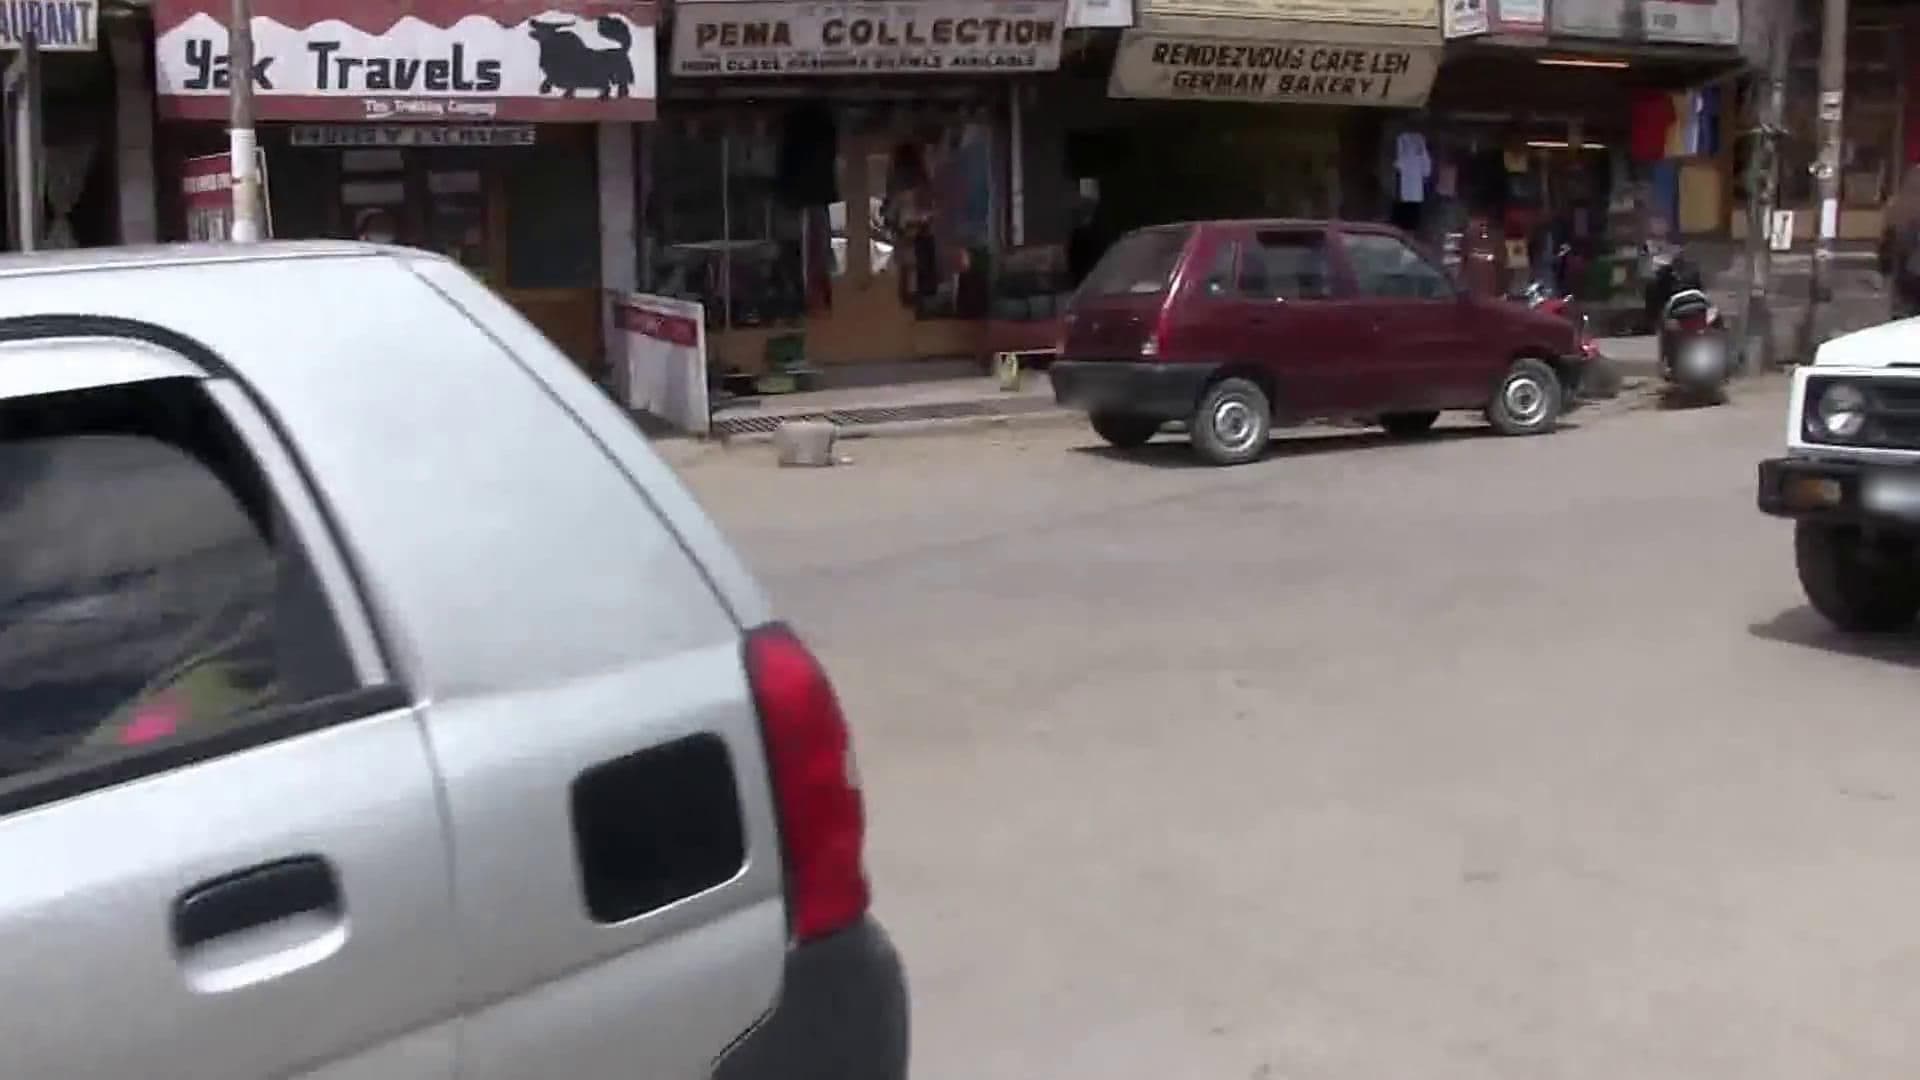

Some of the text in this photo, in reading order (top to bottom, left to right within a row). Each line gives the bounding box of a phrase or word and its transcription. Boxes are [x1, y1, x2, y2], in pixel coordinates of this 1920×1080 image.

[696, 17, 1056, 48] PEMA COLLECTION
[184, 39, 501, 91] Yak Travels
[1151, 42, 1305, 70] RENDEZVOUS
[1310, 49, 1365, 73] CAFE
[1173, 70, 1268, 93] GERMAN
[1279, 74, 1374, 96] BAKERY
